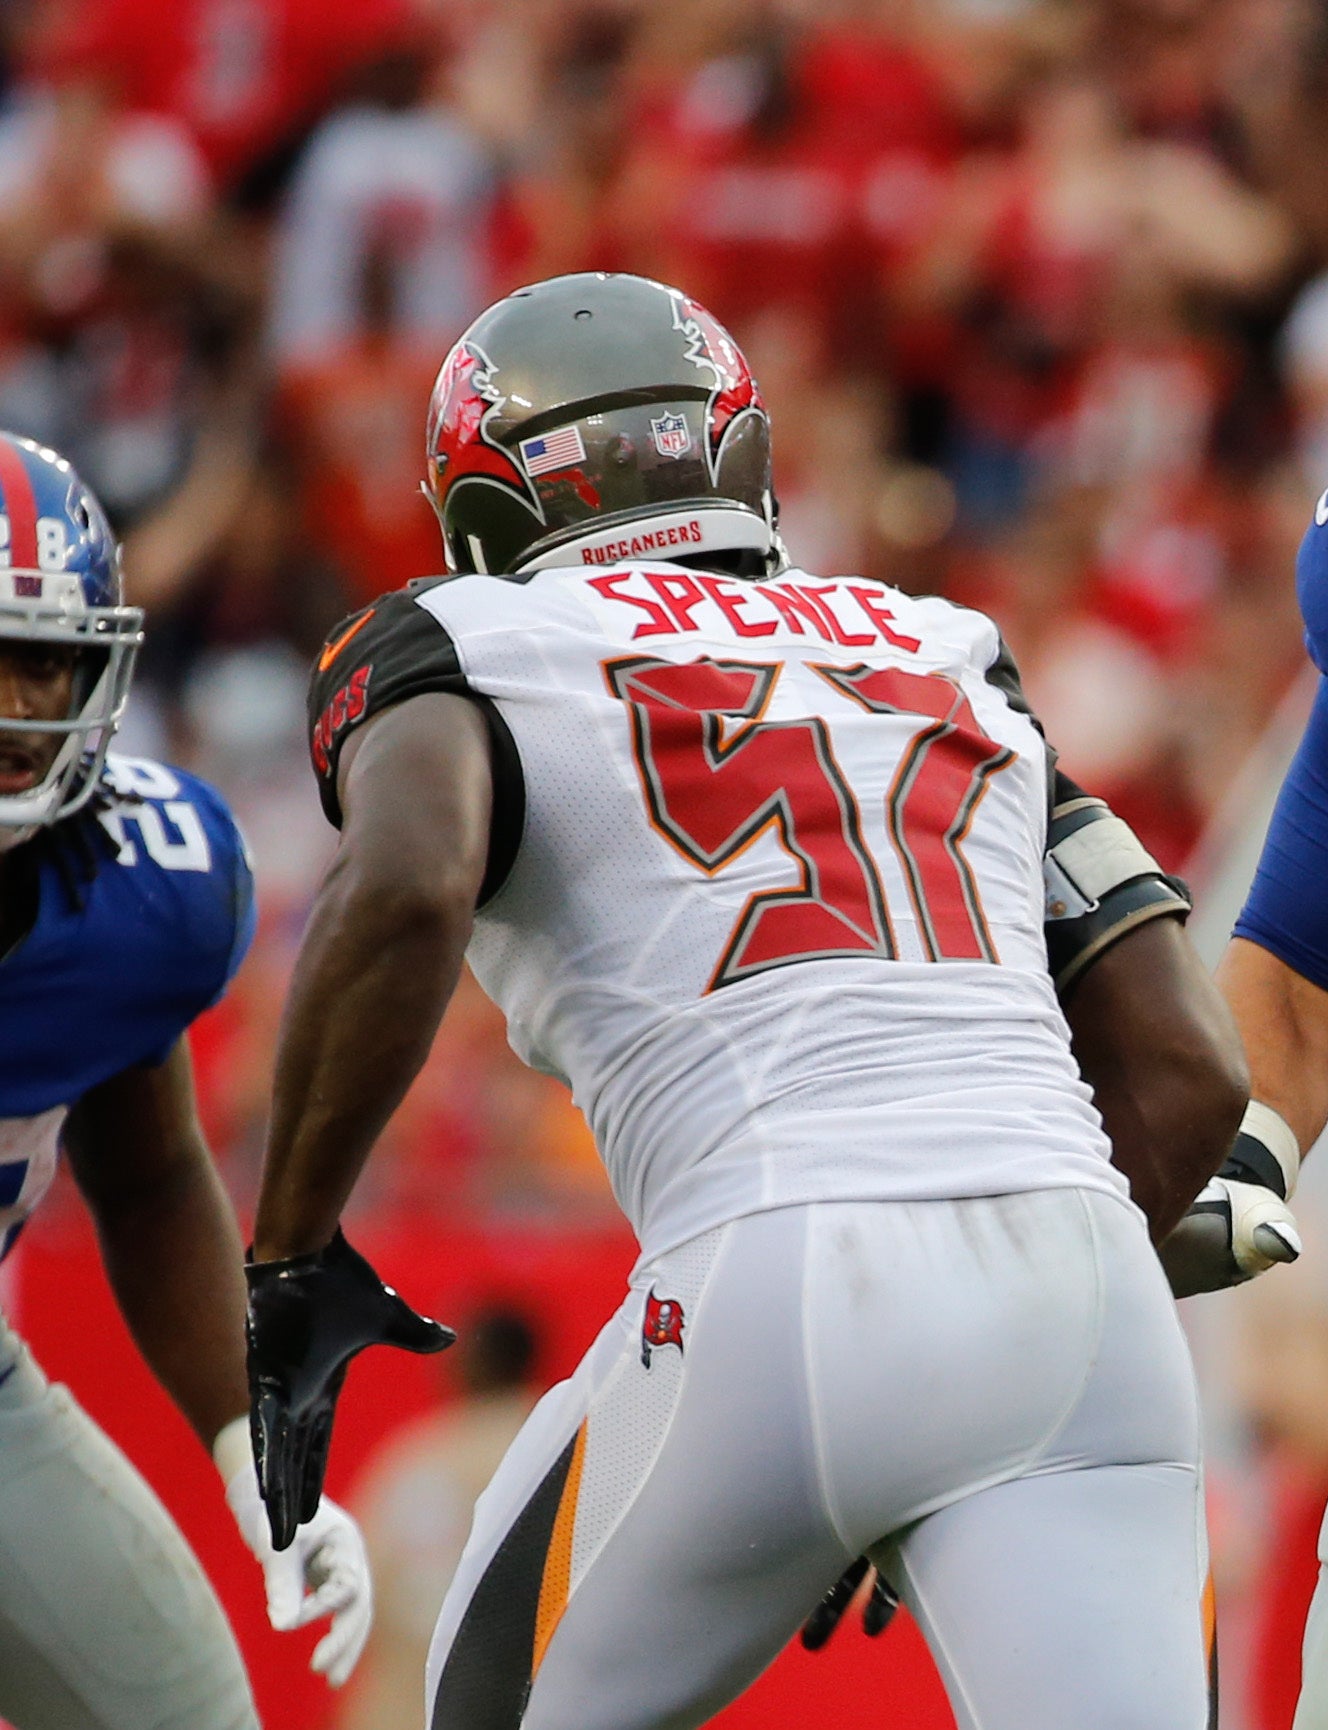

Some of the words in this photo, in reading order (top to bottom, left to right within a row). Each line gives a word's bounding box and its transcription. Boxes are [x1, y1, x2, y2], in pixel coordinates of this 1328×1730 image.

[581, 520, 702, 566] BUCCANEERS
[585, 571, 922, 654] SPENCE
[600, 654, 1018, 998] 57
